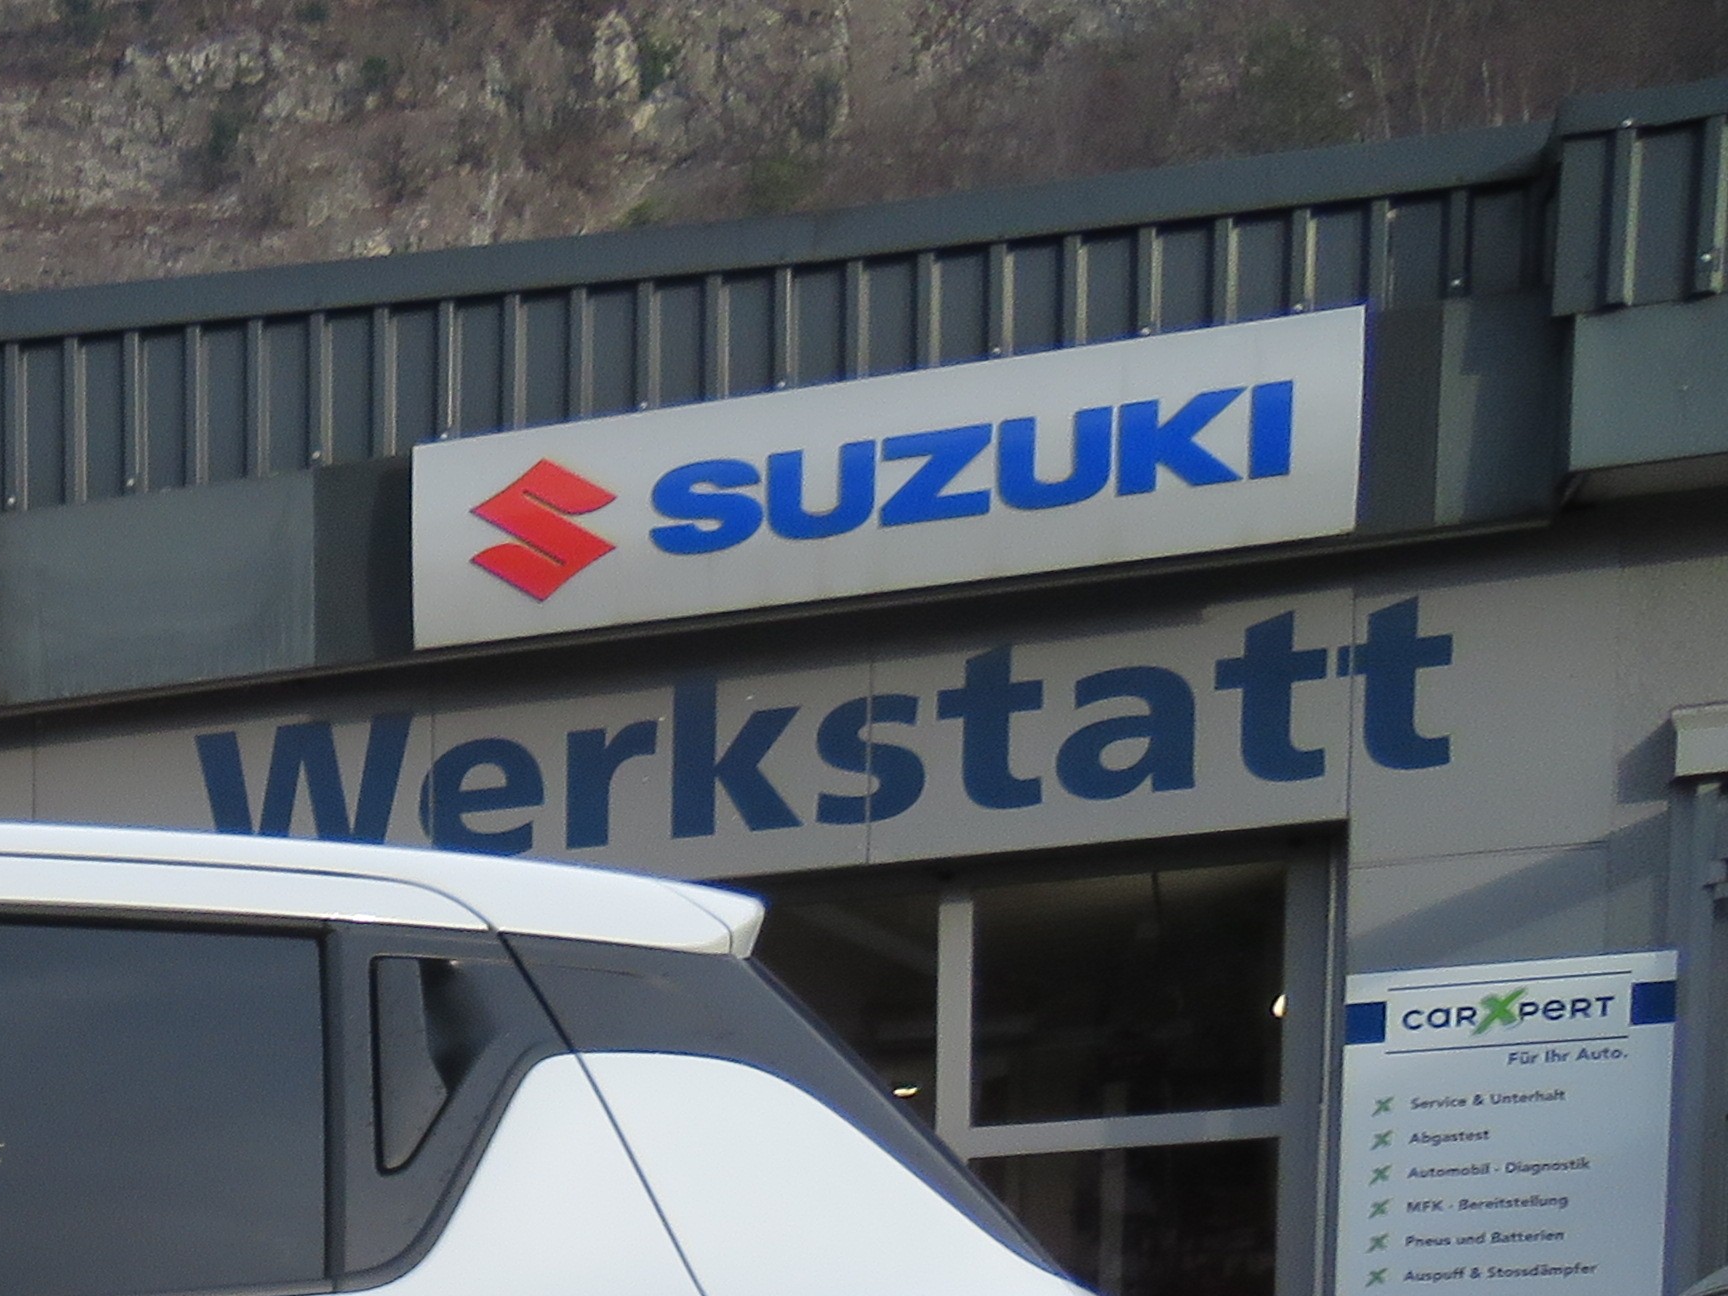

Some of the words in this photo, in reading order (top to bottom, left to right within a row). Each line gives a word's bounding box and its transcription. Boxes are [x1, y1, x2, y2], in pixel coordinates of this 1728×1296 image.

[649, 381, 1295, 555] SUZUKI
[195, 595, 1454, 857] Werkstatt
[1507, 1050, 1536, 1066] Für
[1545, 1049, 1568, 1063] Ihr
[1577, 1048, 1628, 1063] Auto.
[1410, 1097, 1467, 1110] Service
[1472, 1094, 1484, 1107] &
[1490, 1088, 1566, 1105] Unterhalt
[1408, 1129, 1489, 1147] Abgastest
[1407, 1162, 1491, 1178] Automobil
[1505, 1156, 1591, 1176] Diagnostik
[1406, 1200, 1444, 1213] MFK
[1458, 1194, 1569, 1211] Bereitstellung
[1405, 1234, 1451, 1247] Pneus
[1456, 1232, 1485, 1245] und
[1490, 1229, 1565, 1244] Batterien
[1403, 1267, 1465, 1283] Auspuff
[1470, 1266, 1482, 1279] &
[1486, 1261, 1599, 1279] Stossdämpfer
